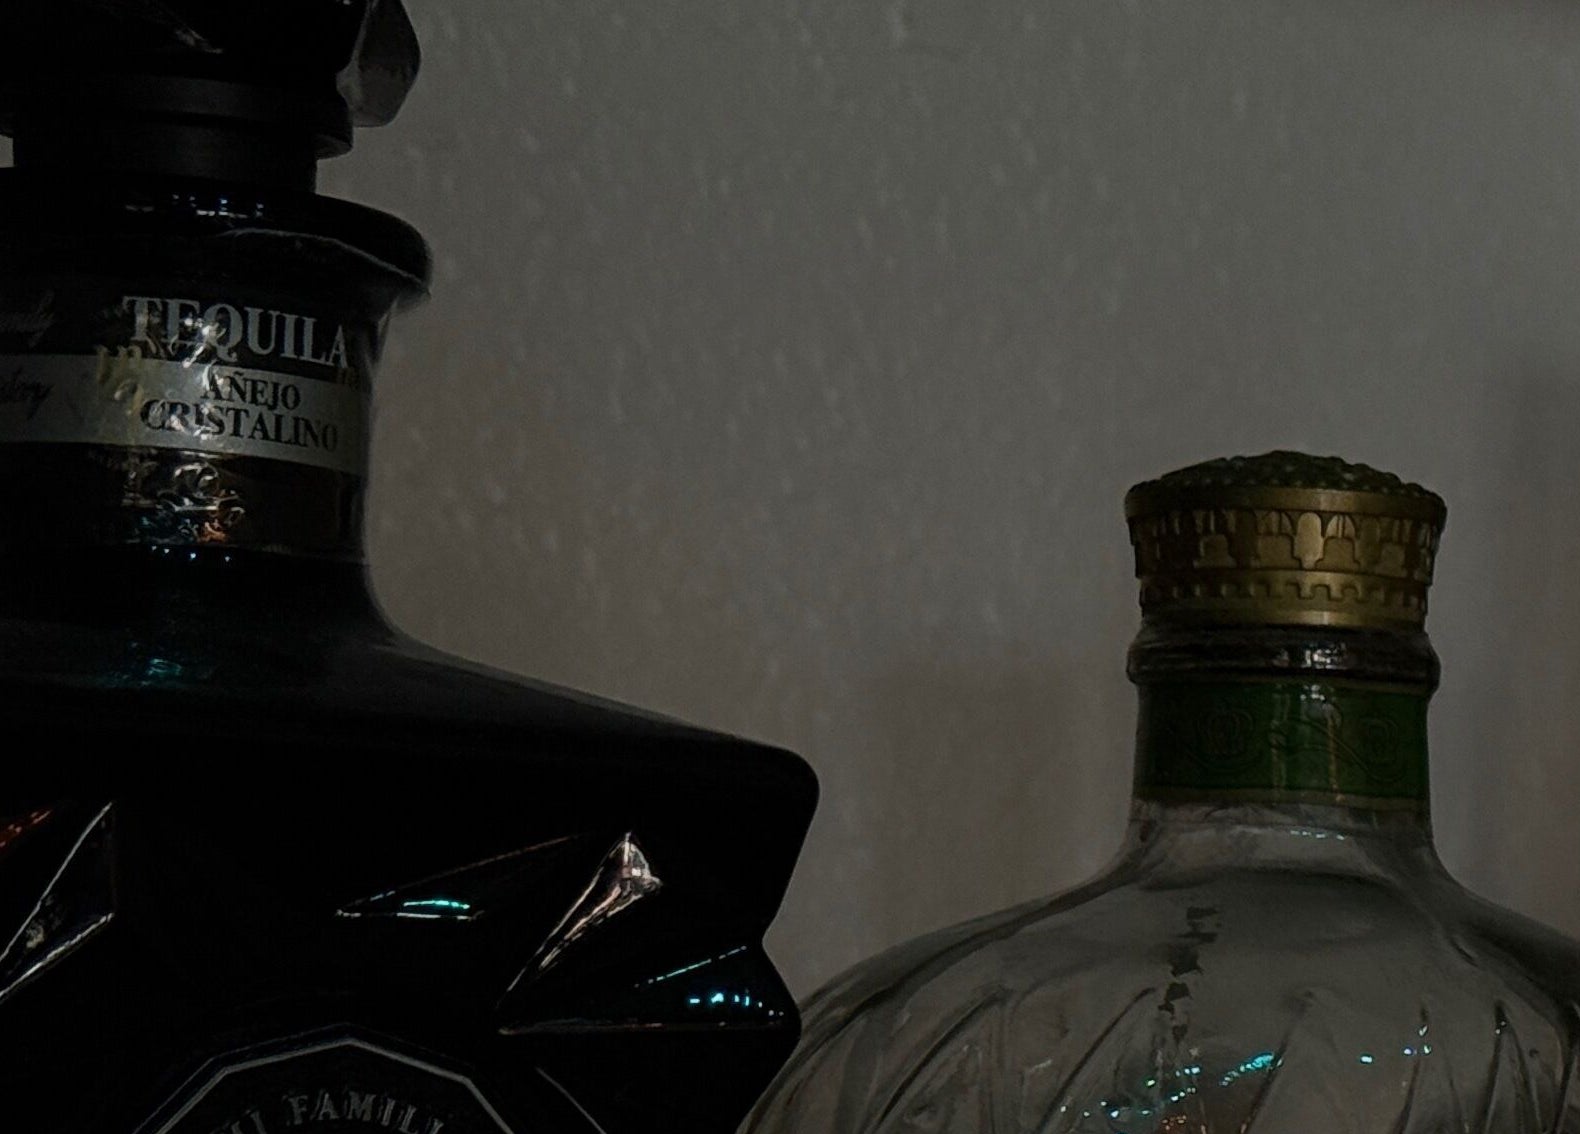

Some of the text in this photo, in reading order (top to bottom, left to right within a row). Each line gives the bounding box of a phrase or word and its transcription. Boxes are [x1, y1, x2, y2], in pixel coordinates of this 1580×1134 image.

[122, 295, 349, 369] TEQUILA
[200, 371, 301, 410] AÑEJO
[140, 399, 338, 450] CRISTALINO
